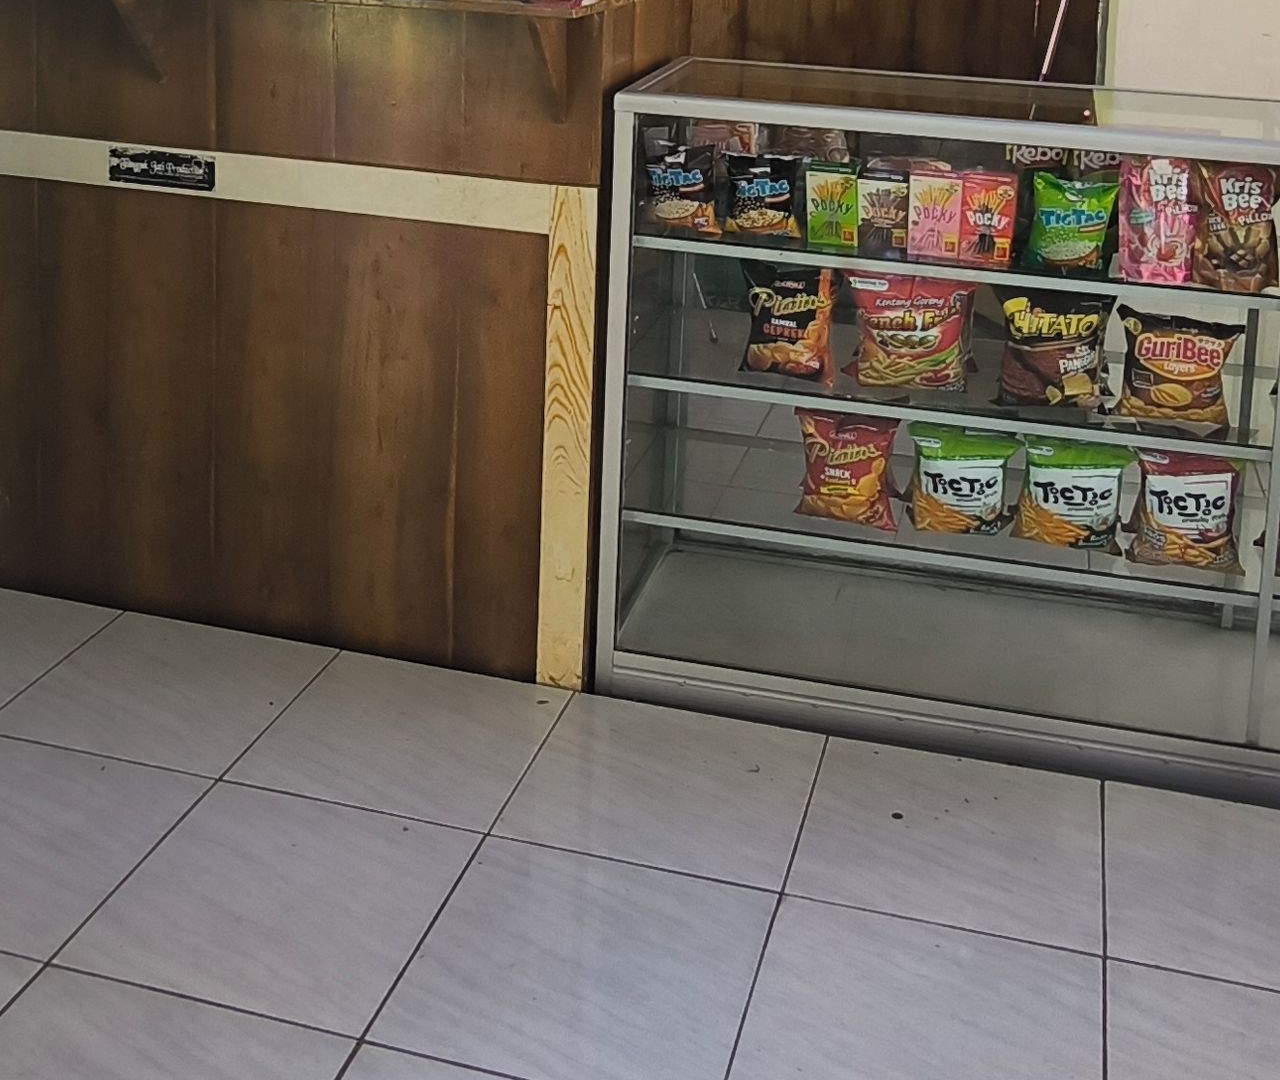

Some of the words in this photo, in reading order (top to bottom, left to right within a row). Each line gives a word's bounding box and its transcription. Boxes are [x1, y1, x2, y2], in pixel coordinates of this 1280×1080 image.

[1150, 184, 1188, 202] Bee
[1221, 177, 1264, 195] Kris
[1222, 193, 1263, 212] Bee
[748, 286, 831, 317] Piattos
[1003, 296, 1100, 340] CHITATO
[1135, 336, 1223, 368] GuriBee
[805, 437, 883, 465] Piattos
